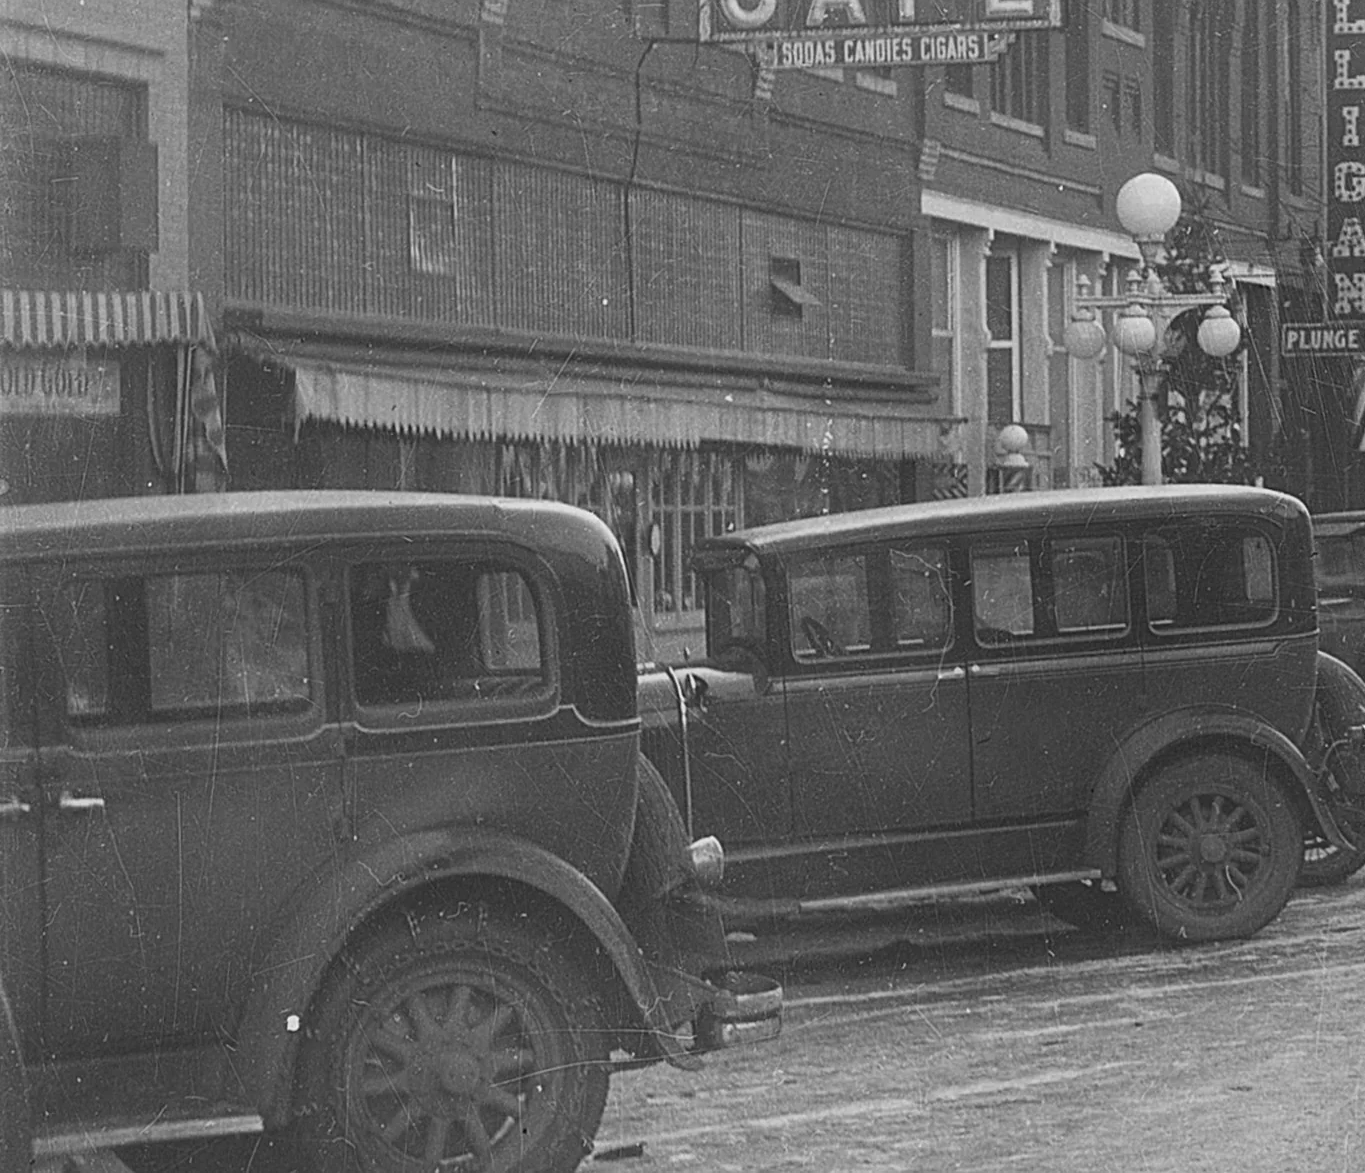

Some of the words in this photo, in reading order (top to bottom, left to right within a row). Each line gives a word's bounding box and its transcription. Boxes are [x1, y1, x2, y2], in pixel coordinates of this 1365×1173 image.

[782, 40, 836, 67] SODAS
[844, 37, 913, 63] CANDIES
[920, 35, 980, 60] CIGARS
[1287, 329, 1360, 350] PLUNGE
